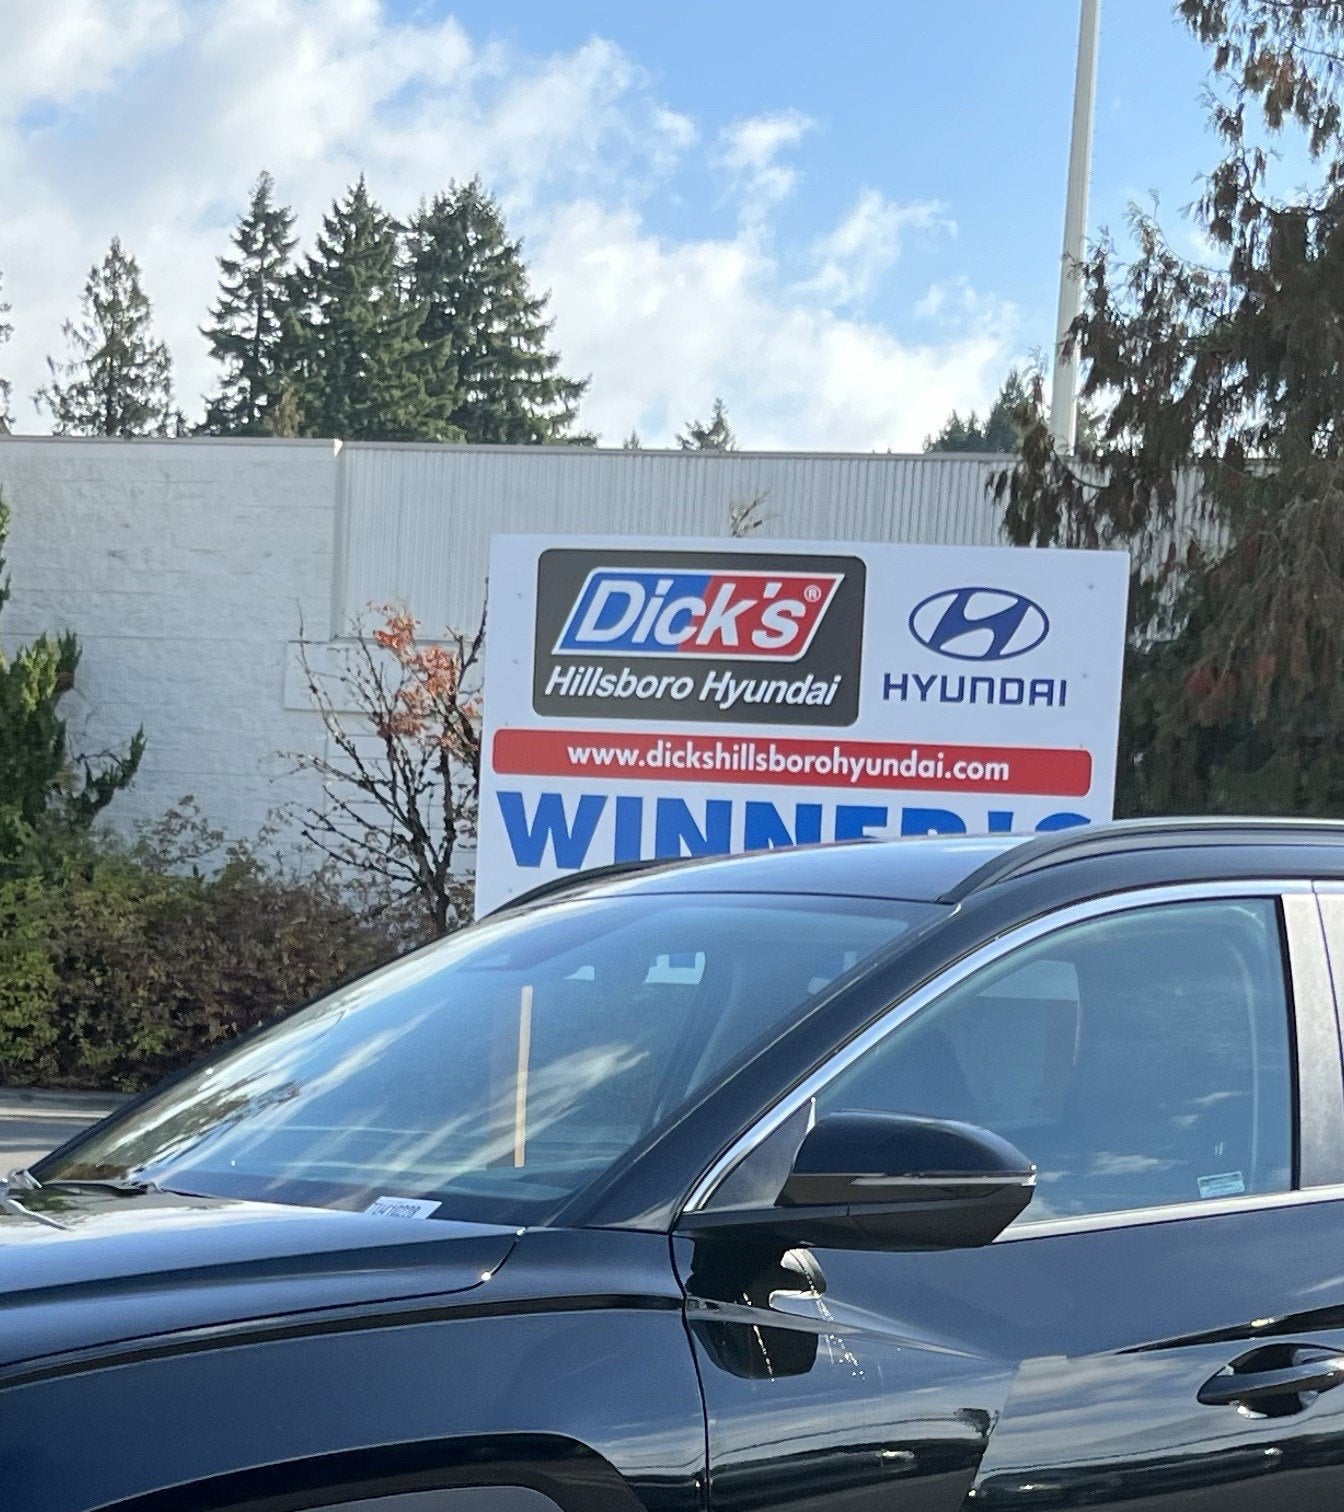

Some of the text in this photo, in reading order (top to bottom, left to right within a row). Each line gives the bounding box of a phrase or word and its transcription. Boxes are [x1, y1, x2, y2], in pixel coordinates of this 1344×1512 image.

[574, 578, 807, 649] Dick's
[544, 664, 843, 710] Hillsboro Hyundai
[882, 672, 1068, 707] HYUNDAI
[566, 740, 1011, 783] www.dickshillsborohyundai.com
